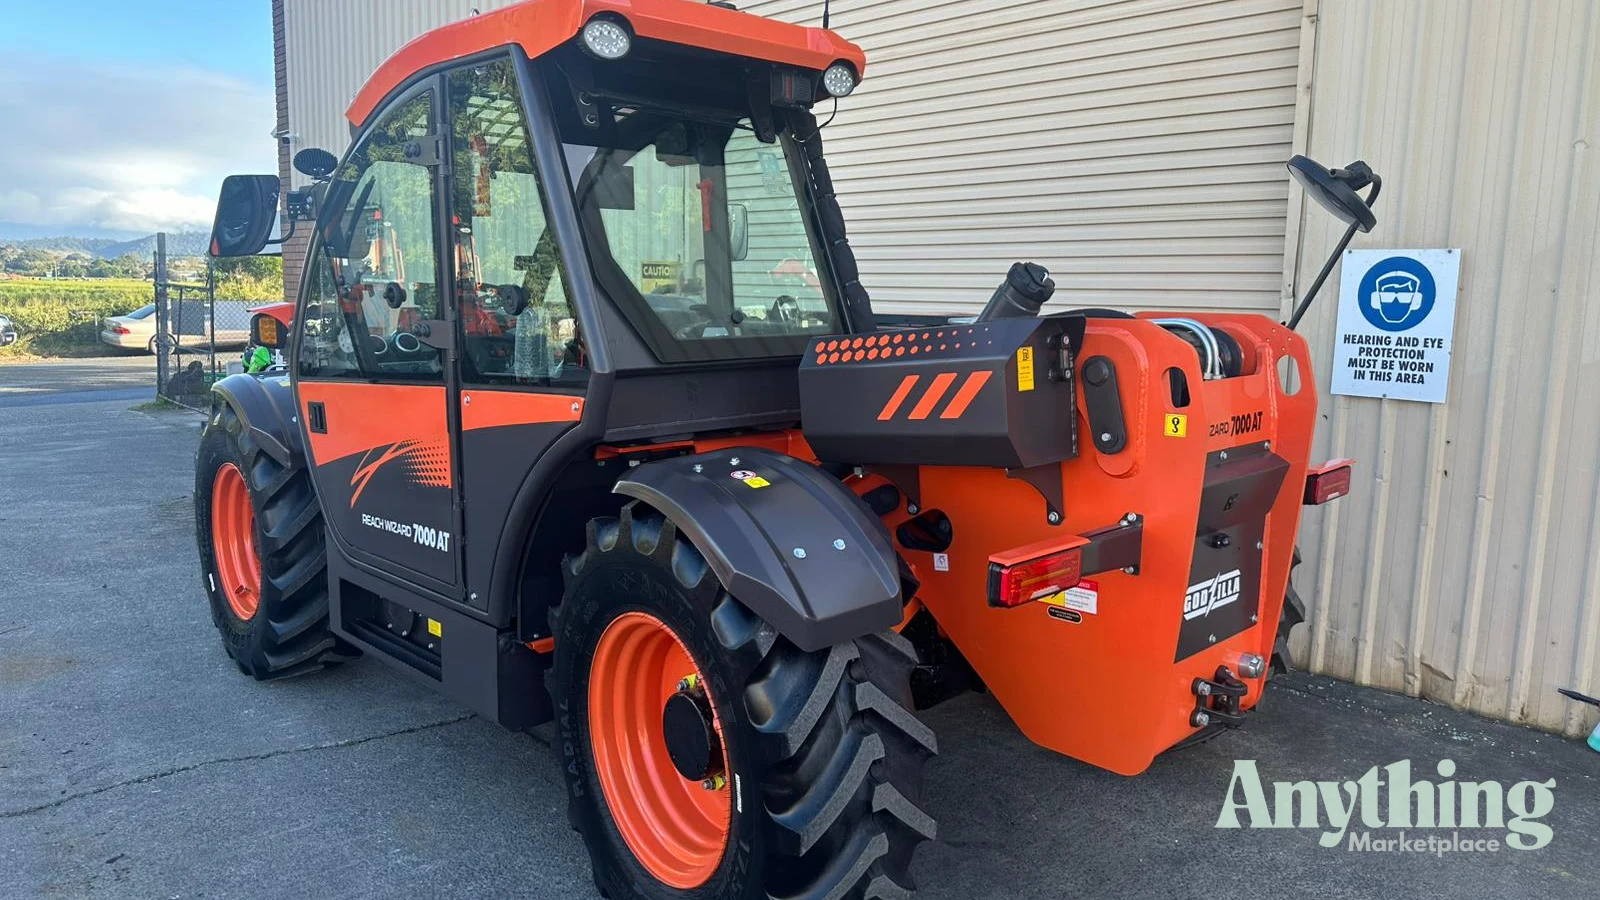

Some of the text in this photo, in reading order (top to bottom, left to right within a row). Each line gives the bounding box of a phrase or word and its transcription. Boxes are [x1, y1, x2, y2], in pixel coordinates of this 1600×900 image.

[1344, 334, 1444, 349] HEARING AND EYE
[1358, 347, 1425, 360] PROTECTION
[1347, 358, 1434, 373] MUST BE WORN
[1353, 370, 1425, 384] IN THIS AREA
[362, 513, 384, 528] REACH
[384, 519, 412, 537] WIZARD
[1183, 572, 1241, 618] GODZILLA
[560, 697, 584, 798] RADIAL
